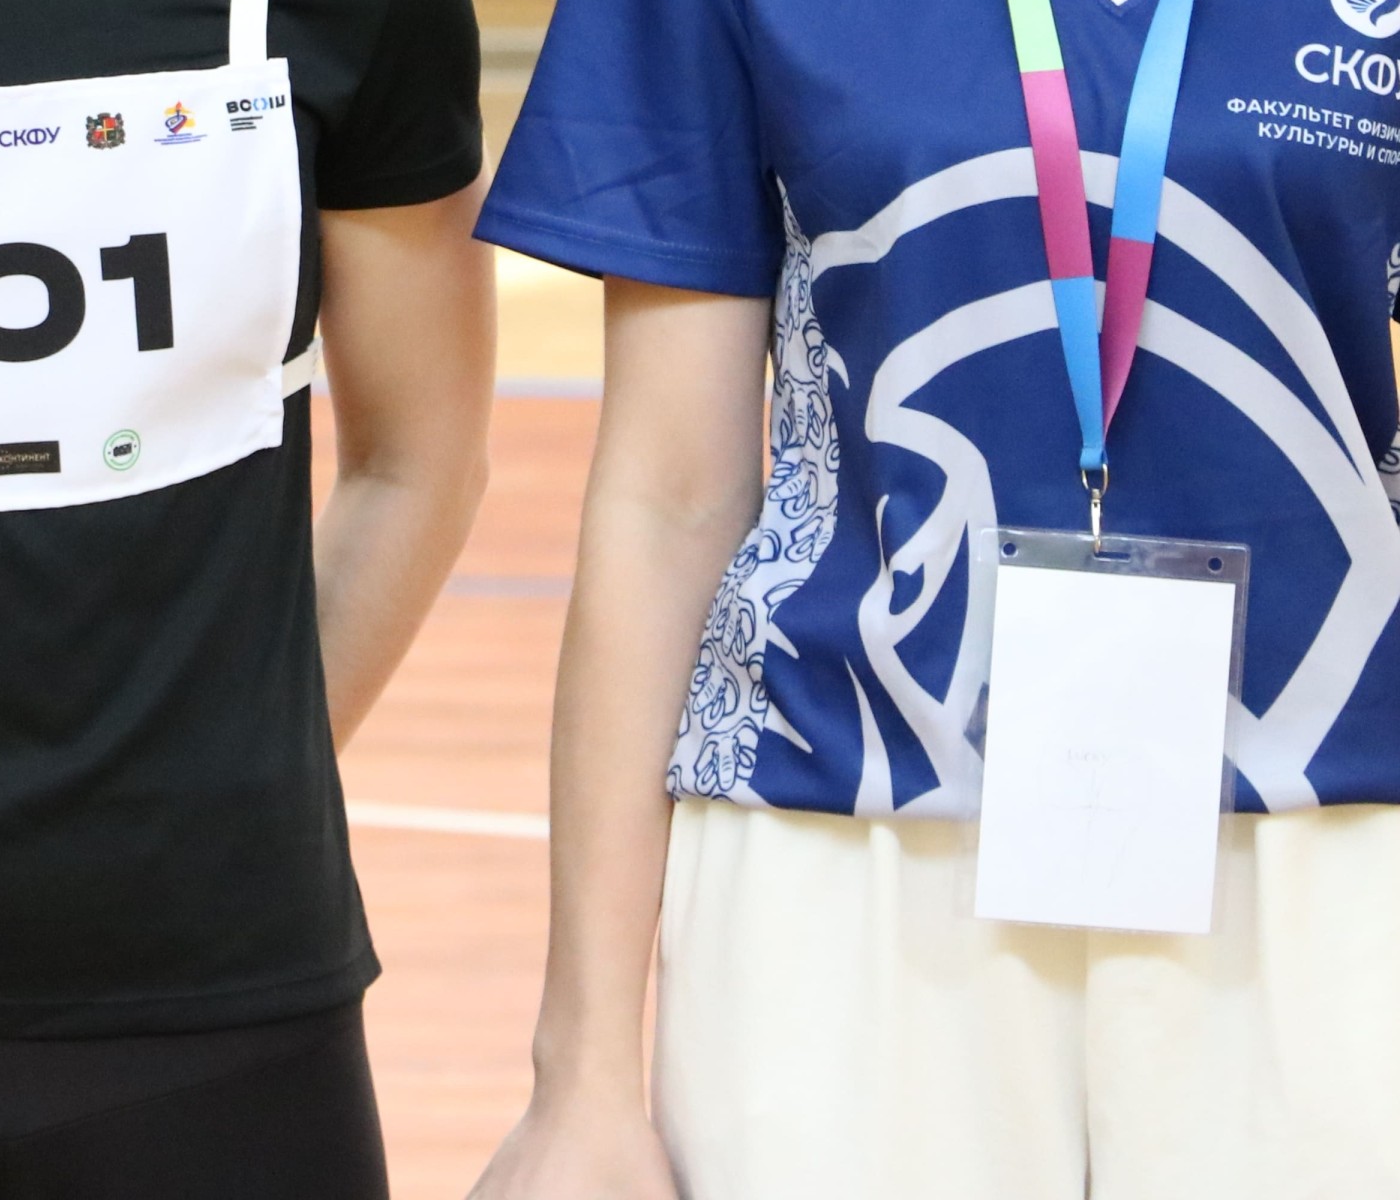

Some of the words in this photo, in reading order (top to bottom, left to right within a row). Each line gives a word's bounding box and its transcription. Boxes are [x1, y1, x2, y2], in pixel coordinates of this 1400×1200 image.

[1295, 43, 1400, 100] СКФ
[1227, 98, 1353, 130] ФАКУЛЬТЕТ
[1259, 122, 1363, 157] КУЛЬТУРЫ
[1366, 144, 1376, 160] И
